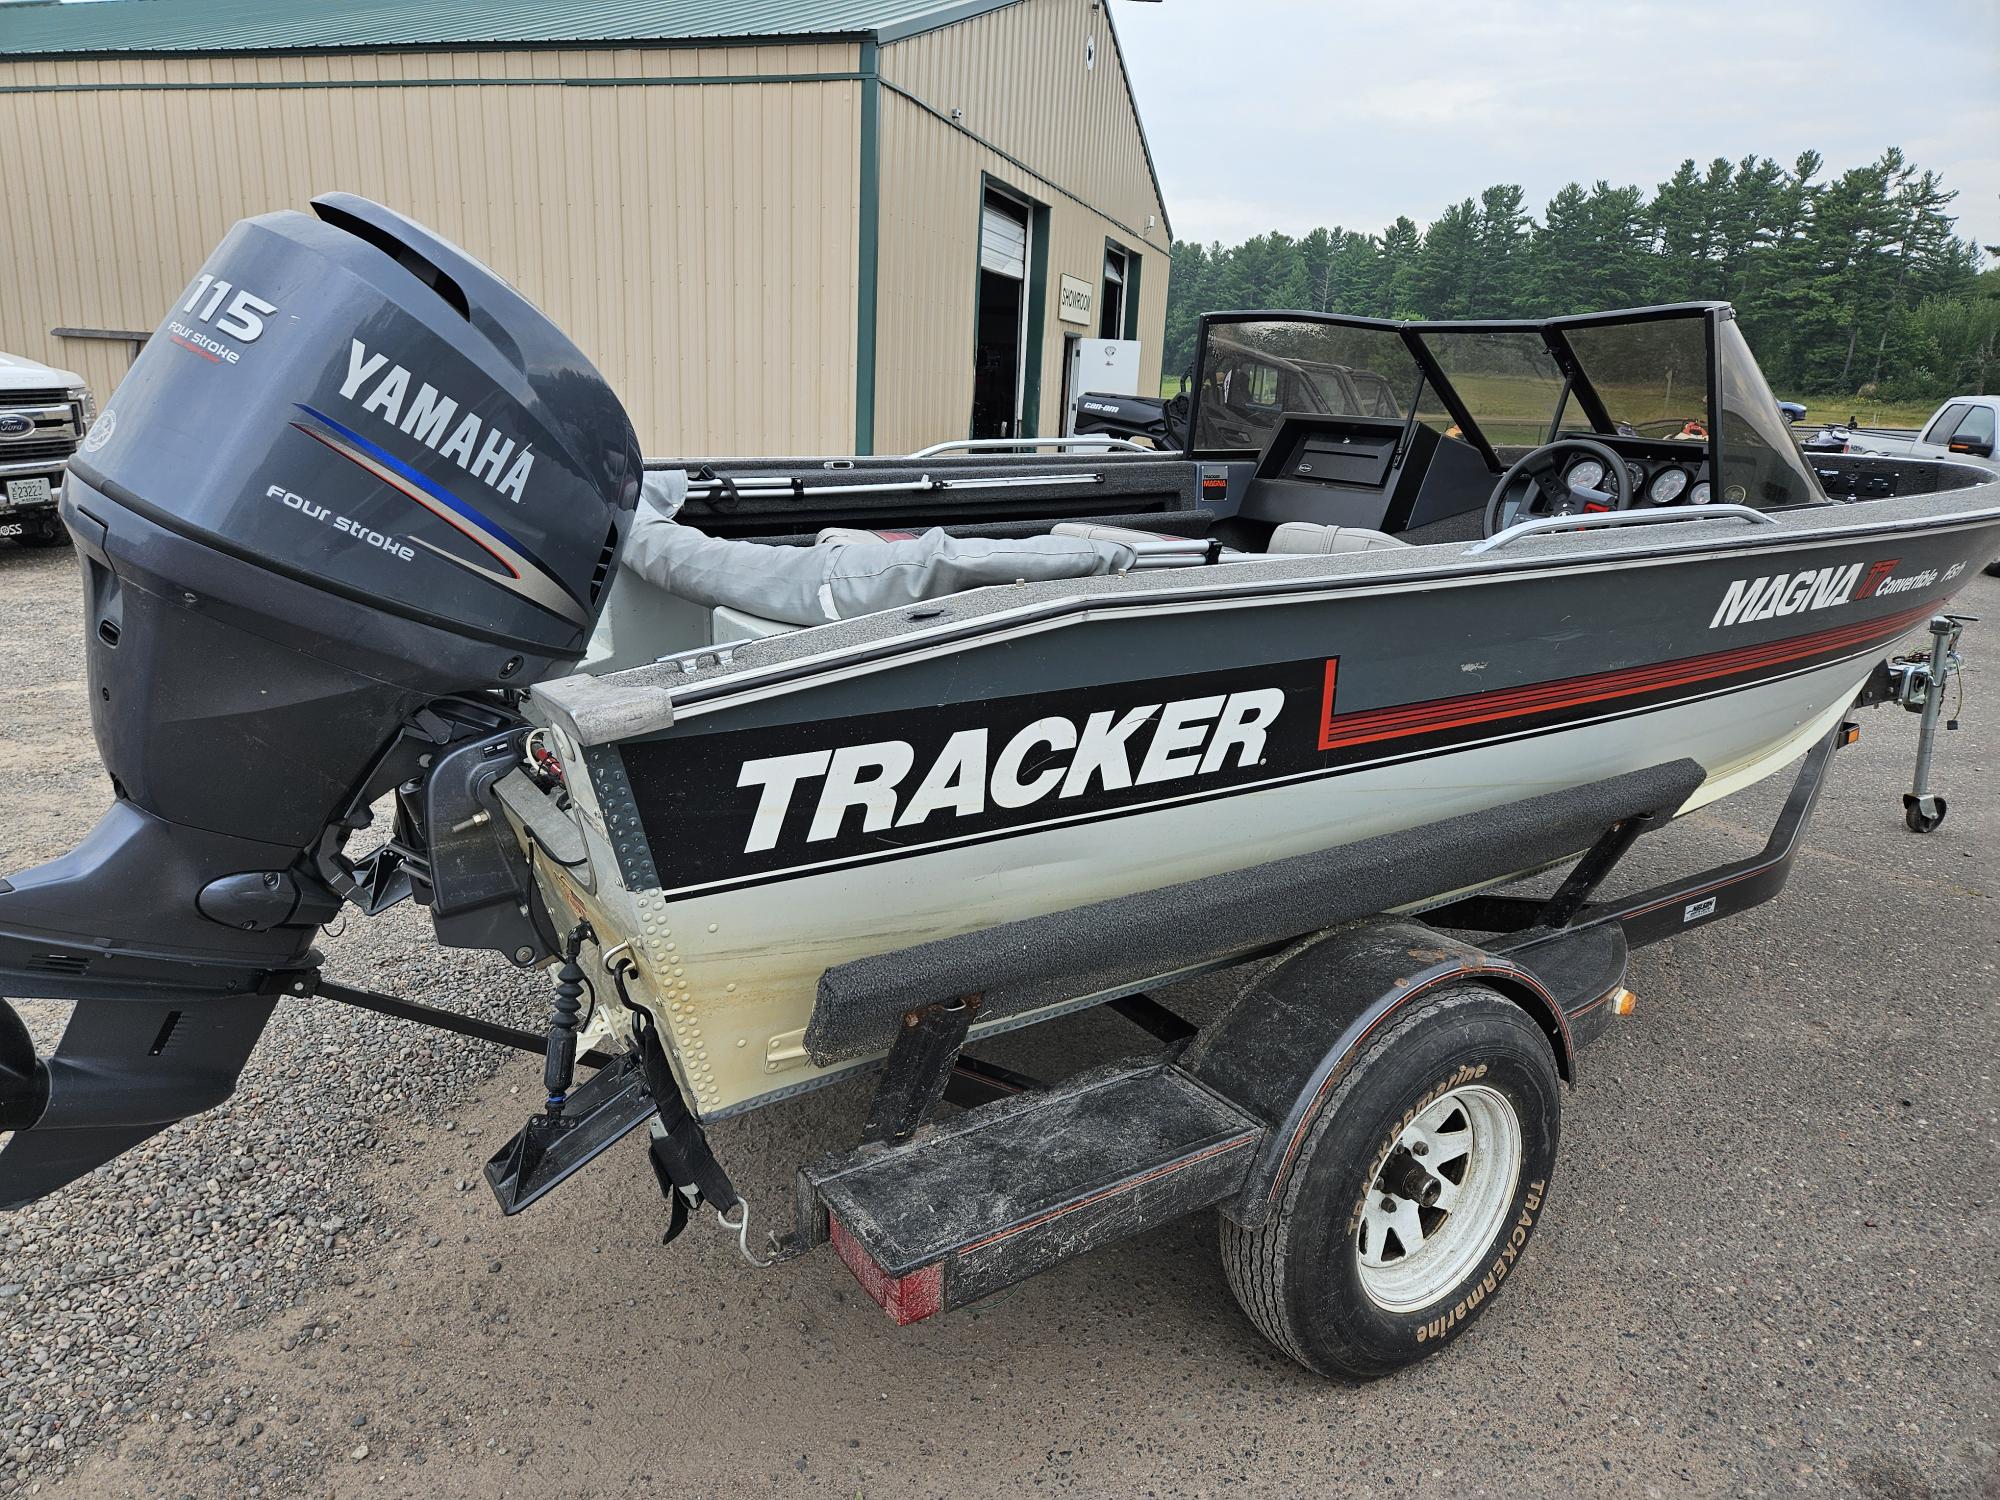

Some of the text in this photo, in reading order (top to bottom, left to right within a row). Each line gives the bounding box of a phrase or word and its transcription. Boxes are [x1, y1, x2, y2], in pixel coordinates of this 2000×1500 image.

[183, 273, 278, 342] 115
[0, 419, 23, 431] Ford
[339, 338, 535, 504] YAMAHA
[1084, 401, 1120, 413] can-am
[0, 523, 23, 536] OSS
[1709, 562, 1864, 629] MAGNA
[1875, 568, 1938, 597] Convertible
[736, 687, 1285, 854] TRACKER
